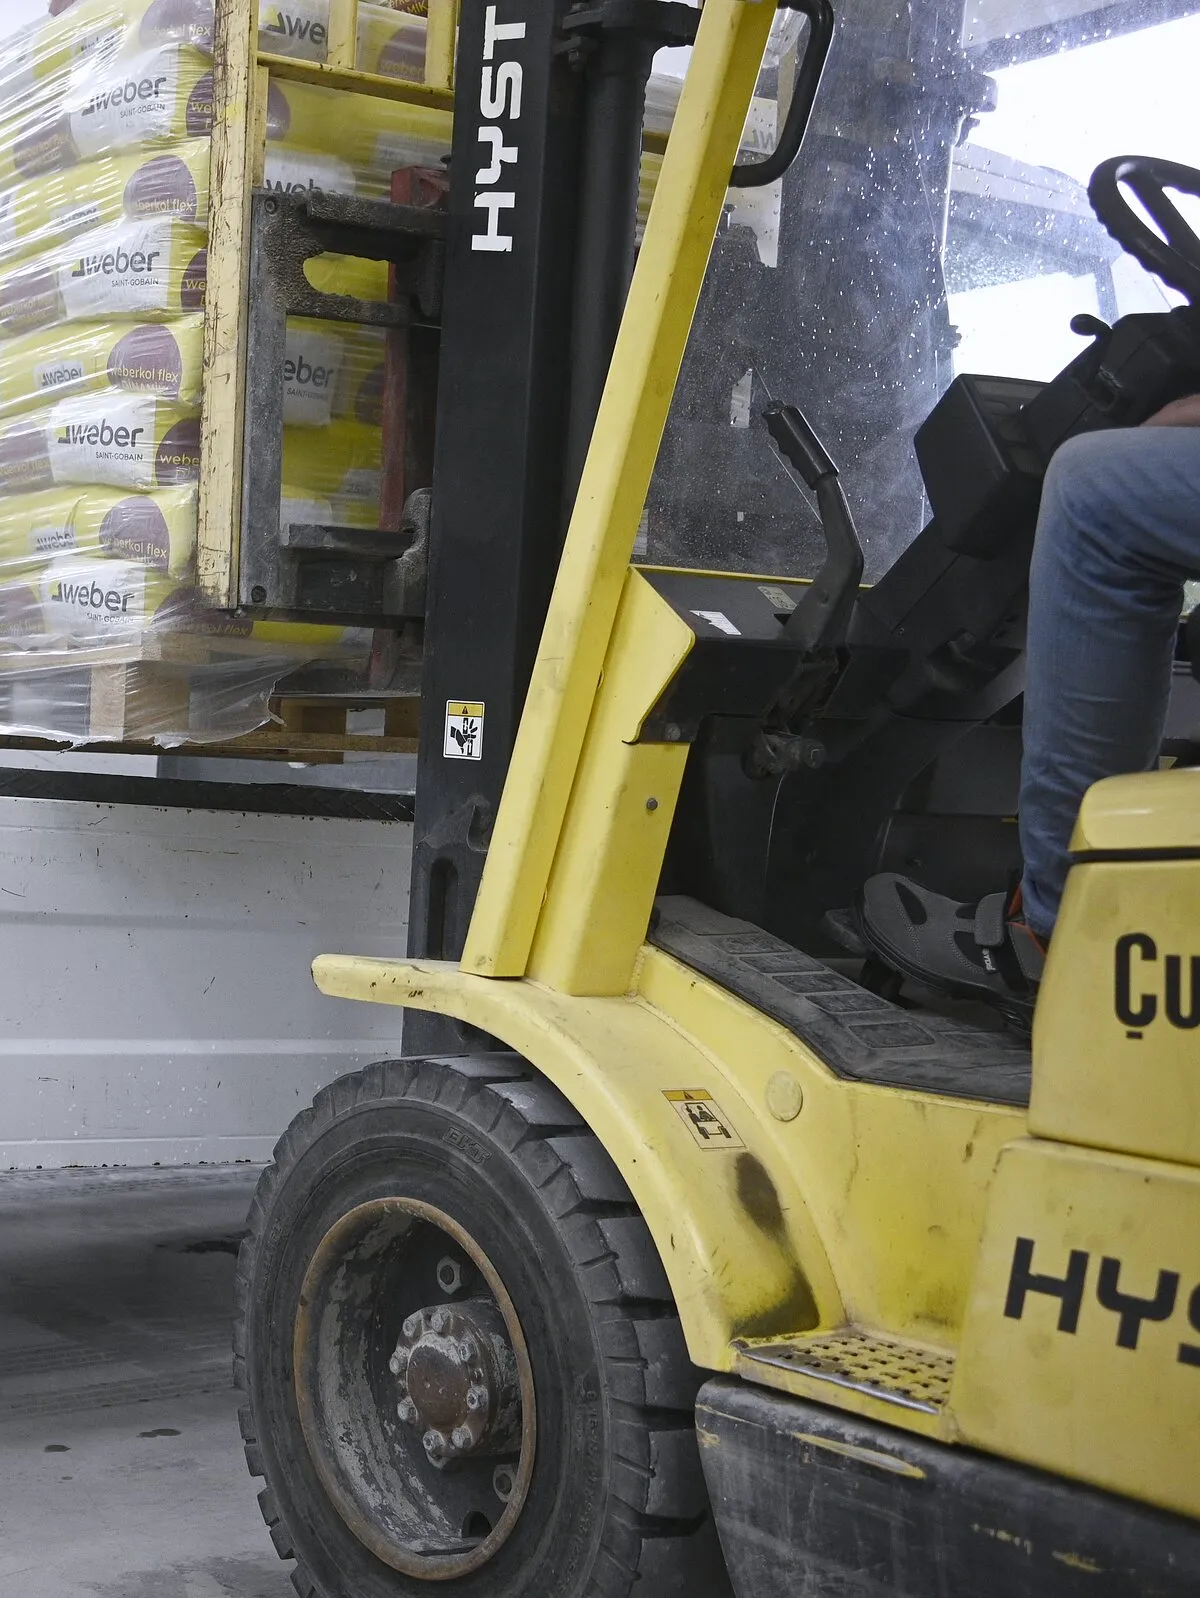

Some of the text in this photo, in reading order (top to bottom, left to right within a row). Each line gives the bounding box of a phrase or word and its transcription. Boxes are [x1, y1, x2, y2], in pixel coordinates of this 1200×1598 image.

[94, 77, 166, 111] weber
[471, 5, 526, 252] HYST
[172, 197, 193, 212] flex
[86, 246, 160, 275] weber
[111, 278, 159, 288] SAINT-GOBAIN
[46, 364, 82, 386] weber
[157, 368, 179, 383] flex
[284, 355, 334, 388] eber
[71, 418, 144, 448] weber
[95, 451, 144, 461] SAINT-GOBAIN
[160, 452, 200, 466] webe
[147, 541, 167, 559] flex
[62, 580, 135, 612] weber
